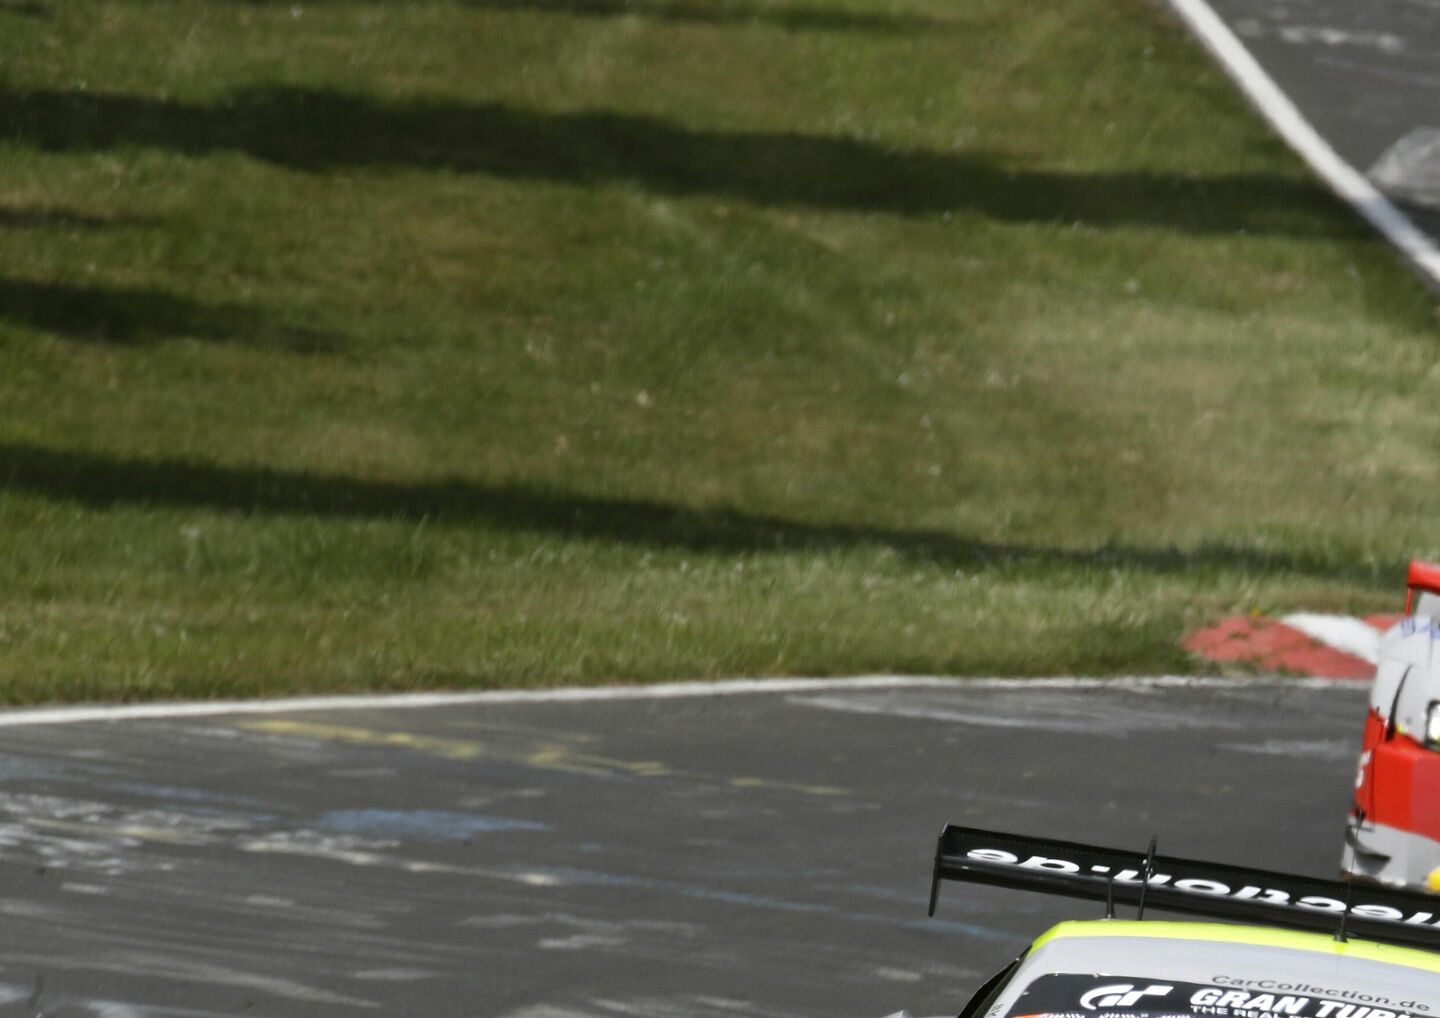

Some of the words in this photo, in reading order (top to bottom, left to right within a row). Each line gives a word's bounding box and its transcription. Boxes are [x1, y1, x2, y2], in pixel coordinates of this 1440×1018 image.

[1189, 988, 1309, 1015] GRAN
[1212, 975, 1431, 1012] CarCollection.de
[1189, 1005, 1228, 1016] THE
